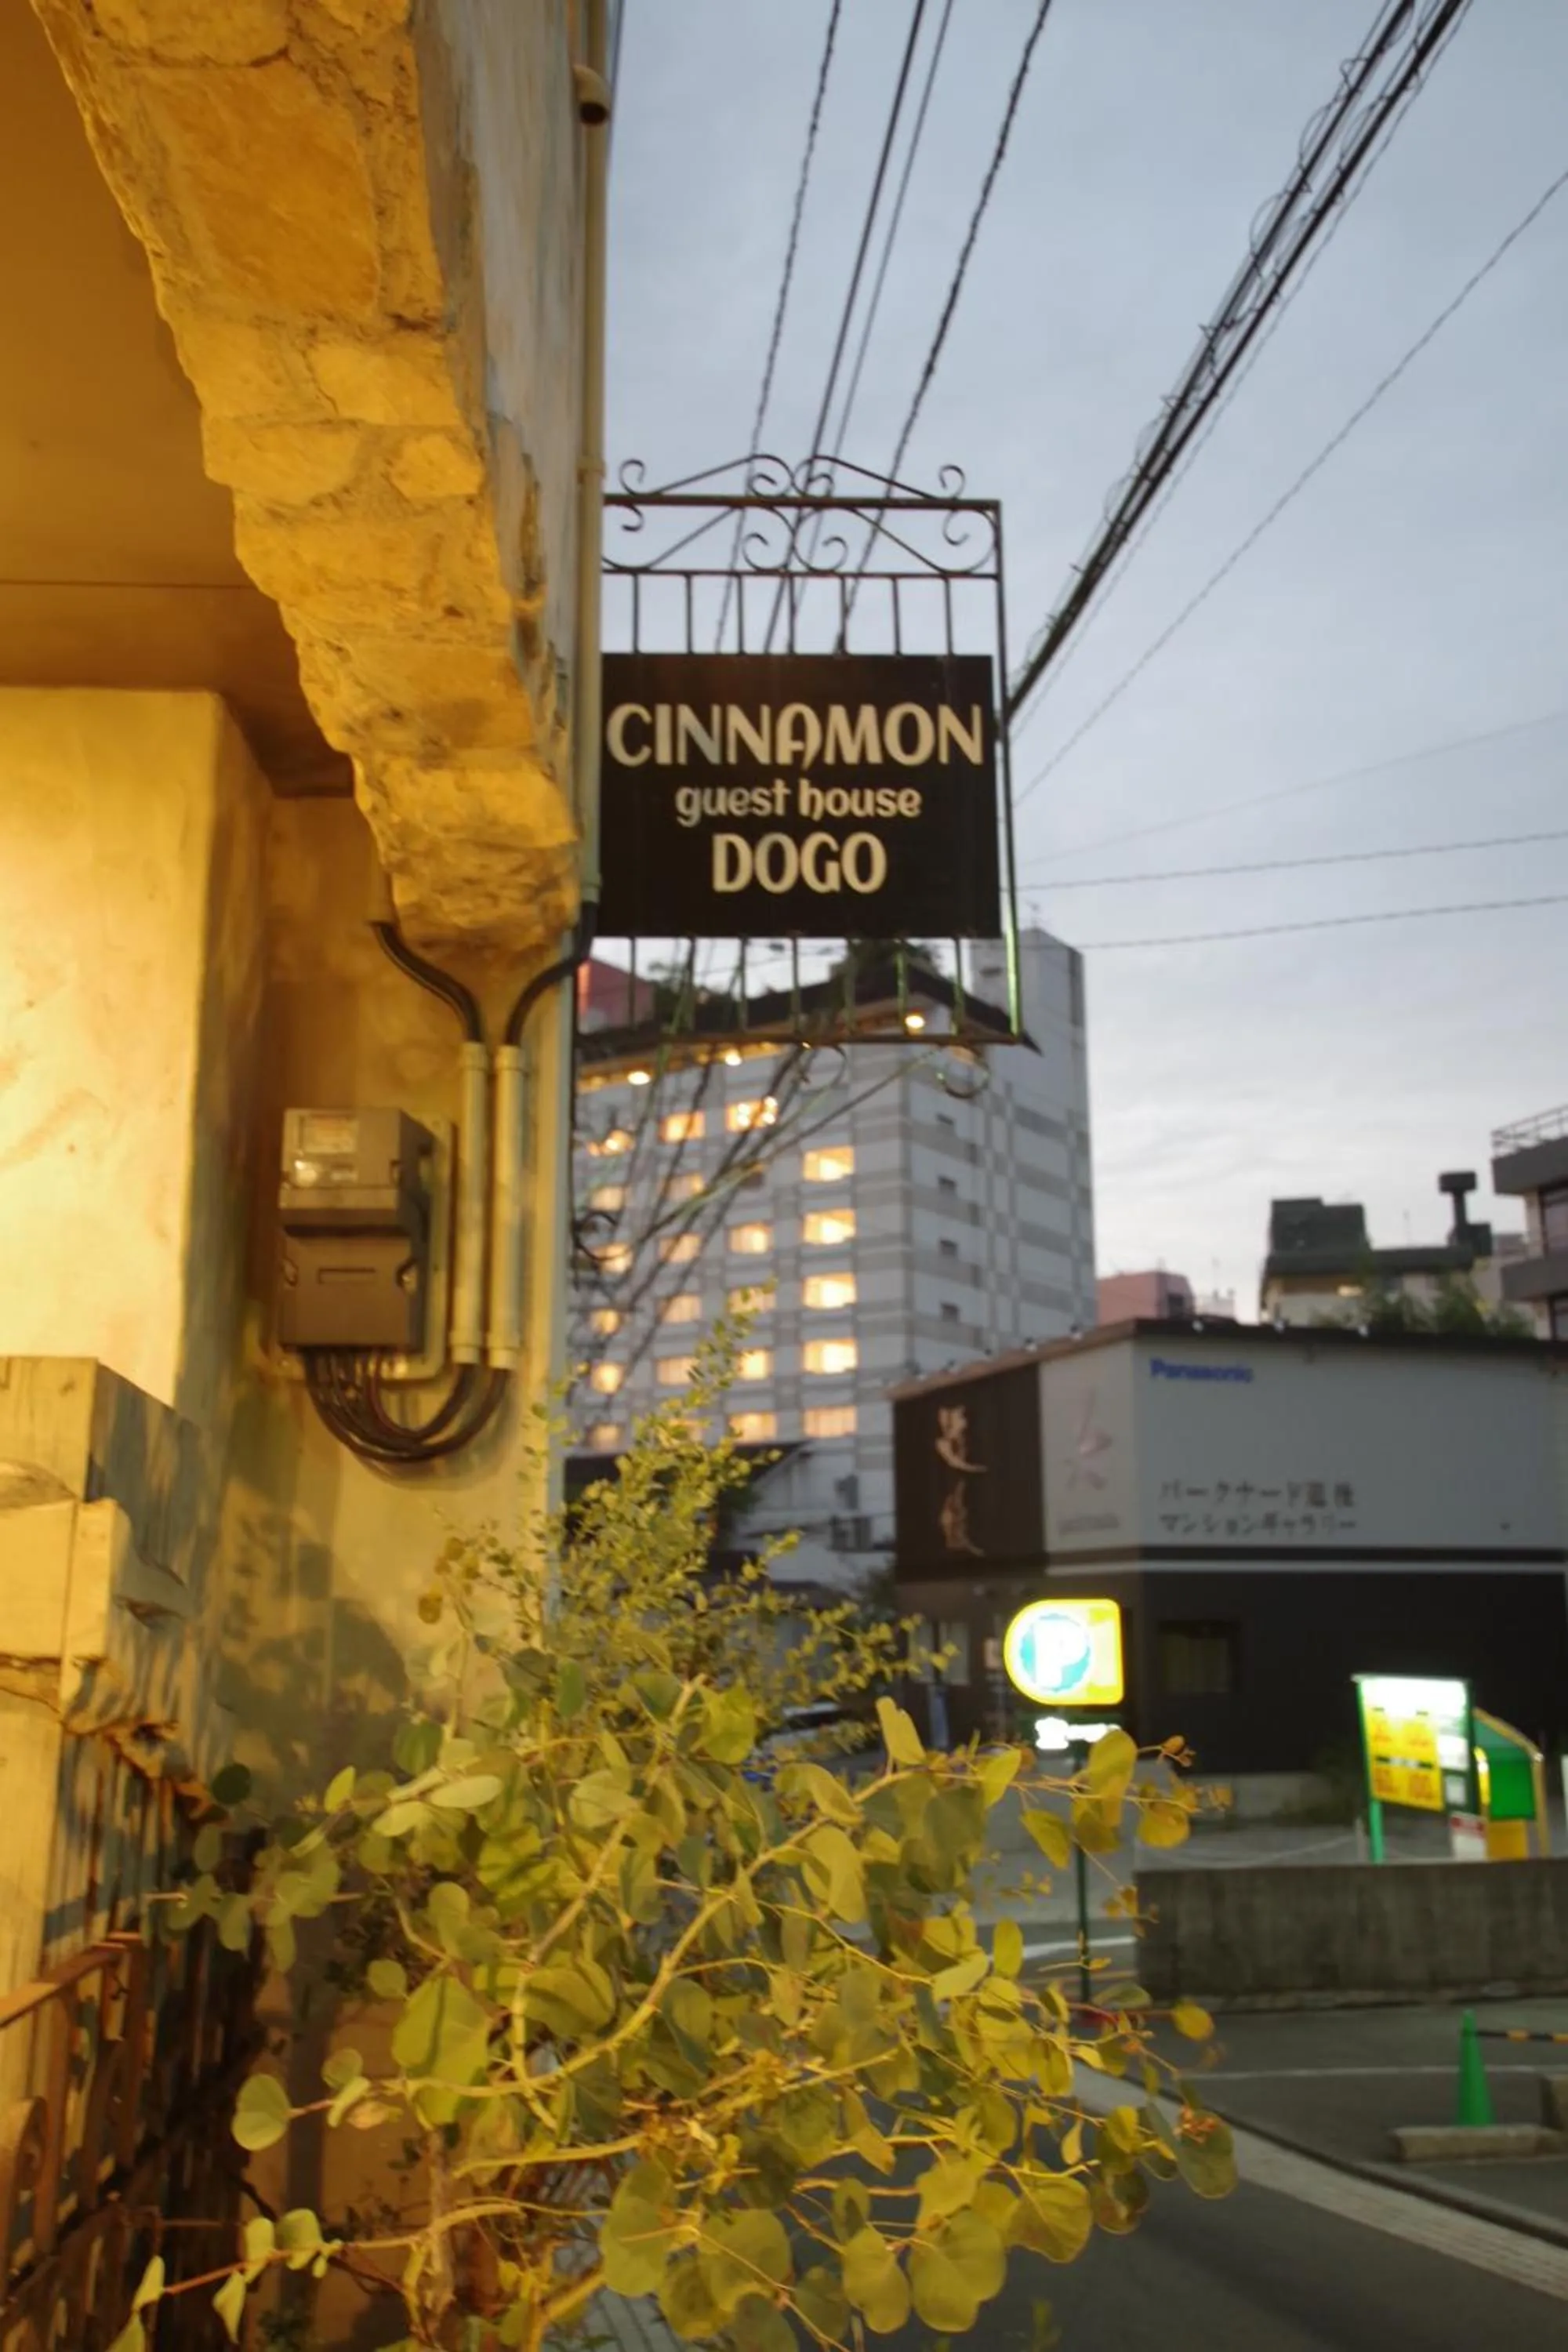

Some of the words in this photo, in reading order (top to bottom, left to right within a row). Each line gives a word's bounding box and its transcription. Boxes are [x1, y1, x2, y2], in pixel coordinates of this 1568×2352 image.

[606, 702, 984, 770] CINNAMON
[675, 779, 790, 828] guest
[798, 779, 923, 822] house
[712, 832, 887, 894] DOGO
[1150, 1358, 1254, 1383] Panasonic
[1035, 1620, 1090, 1689] P
